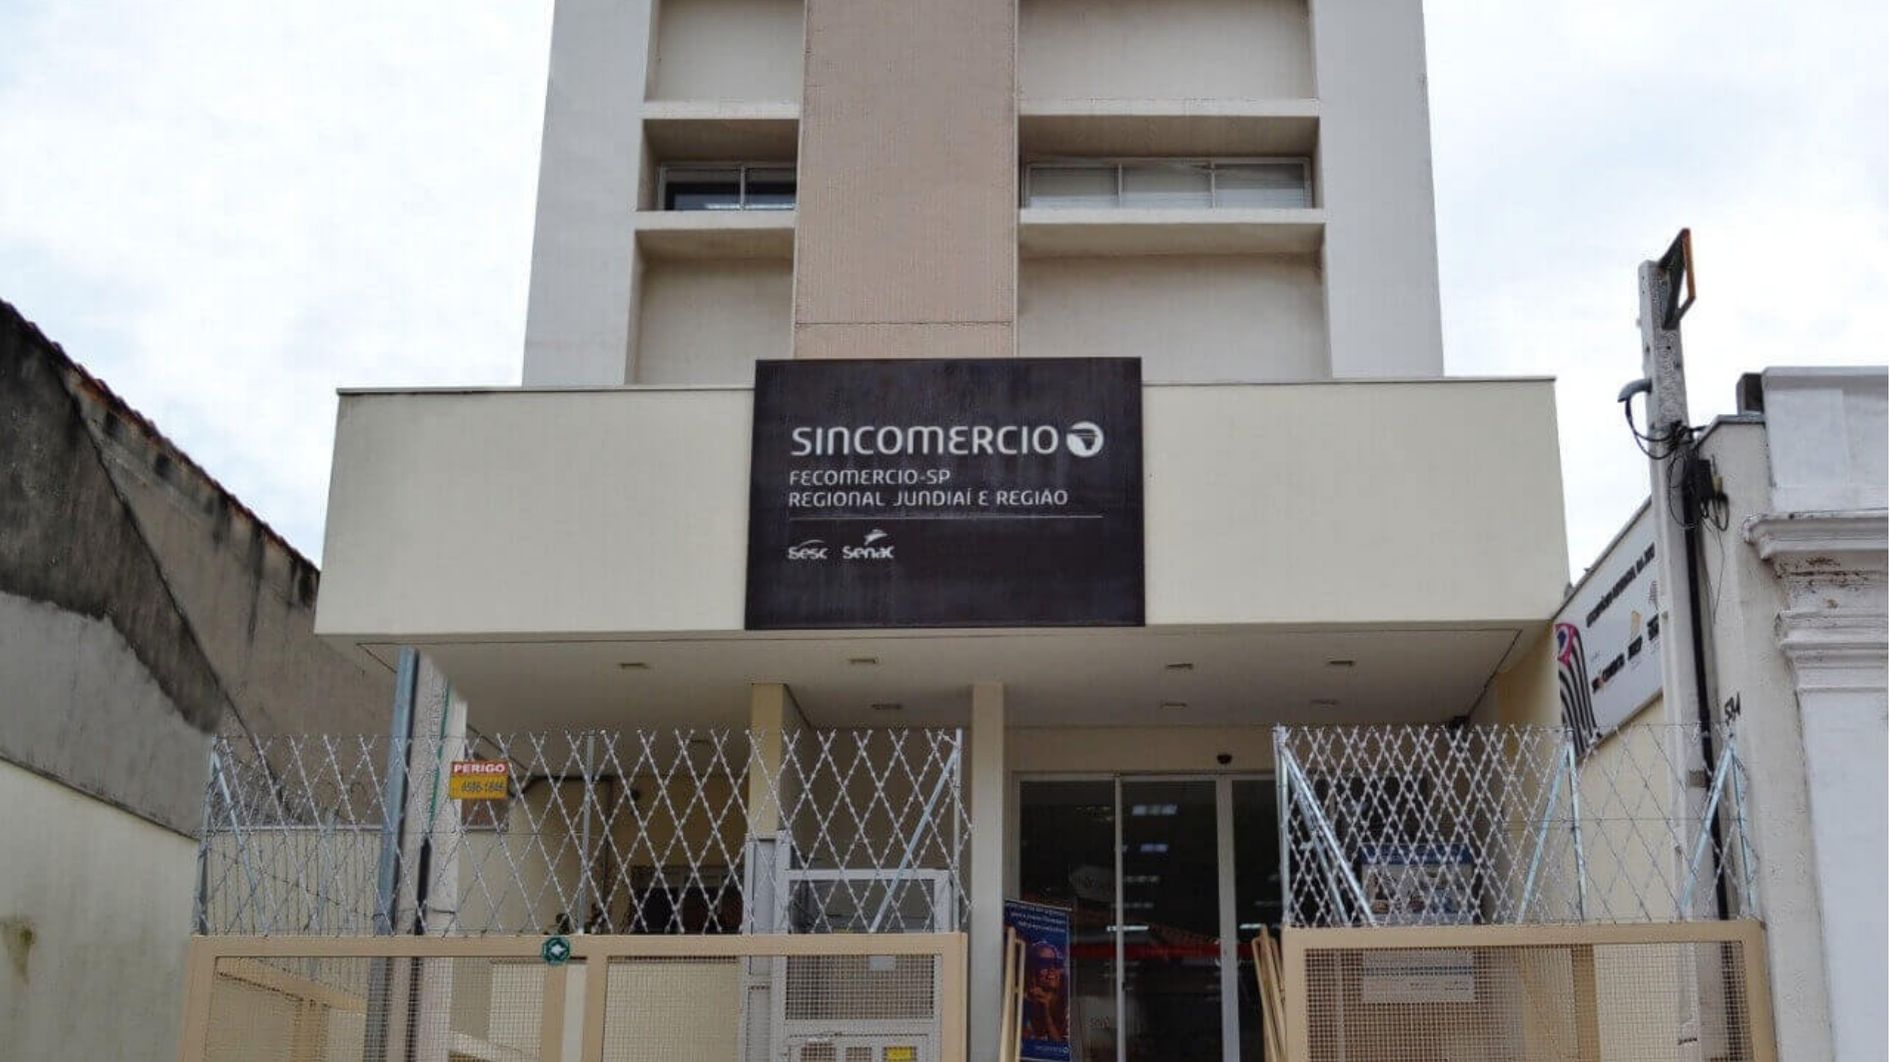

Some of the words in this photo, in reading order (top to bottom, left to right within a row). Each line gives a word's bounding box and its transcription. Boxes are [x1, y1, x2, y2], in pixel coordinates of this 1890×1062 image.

[790, 425, 1059, 456] SINCOMERCIO
[789, 469, 951, 486] FECOMERCIO-SP
[788, 491, 886, 508] REGIONAL
[893, 488, 973, 506] JUNDIAÍ
[978, 490, 989, 506] E
[453, 763, 506, 773] PERIGO
